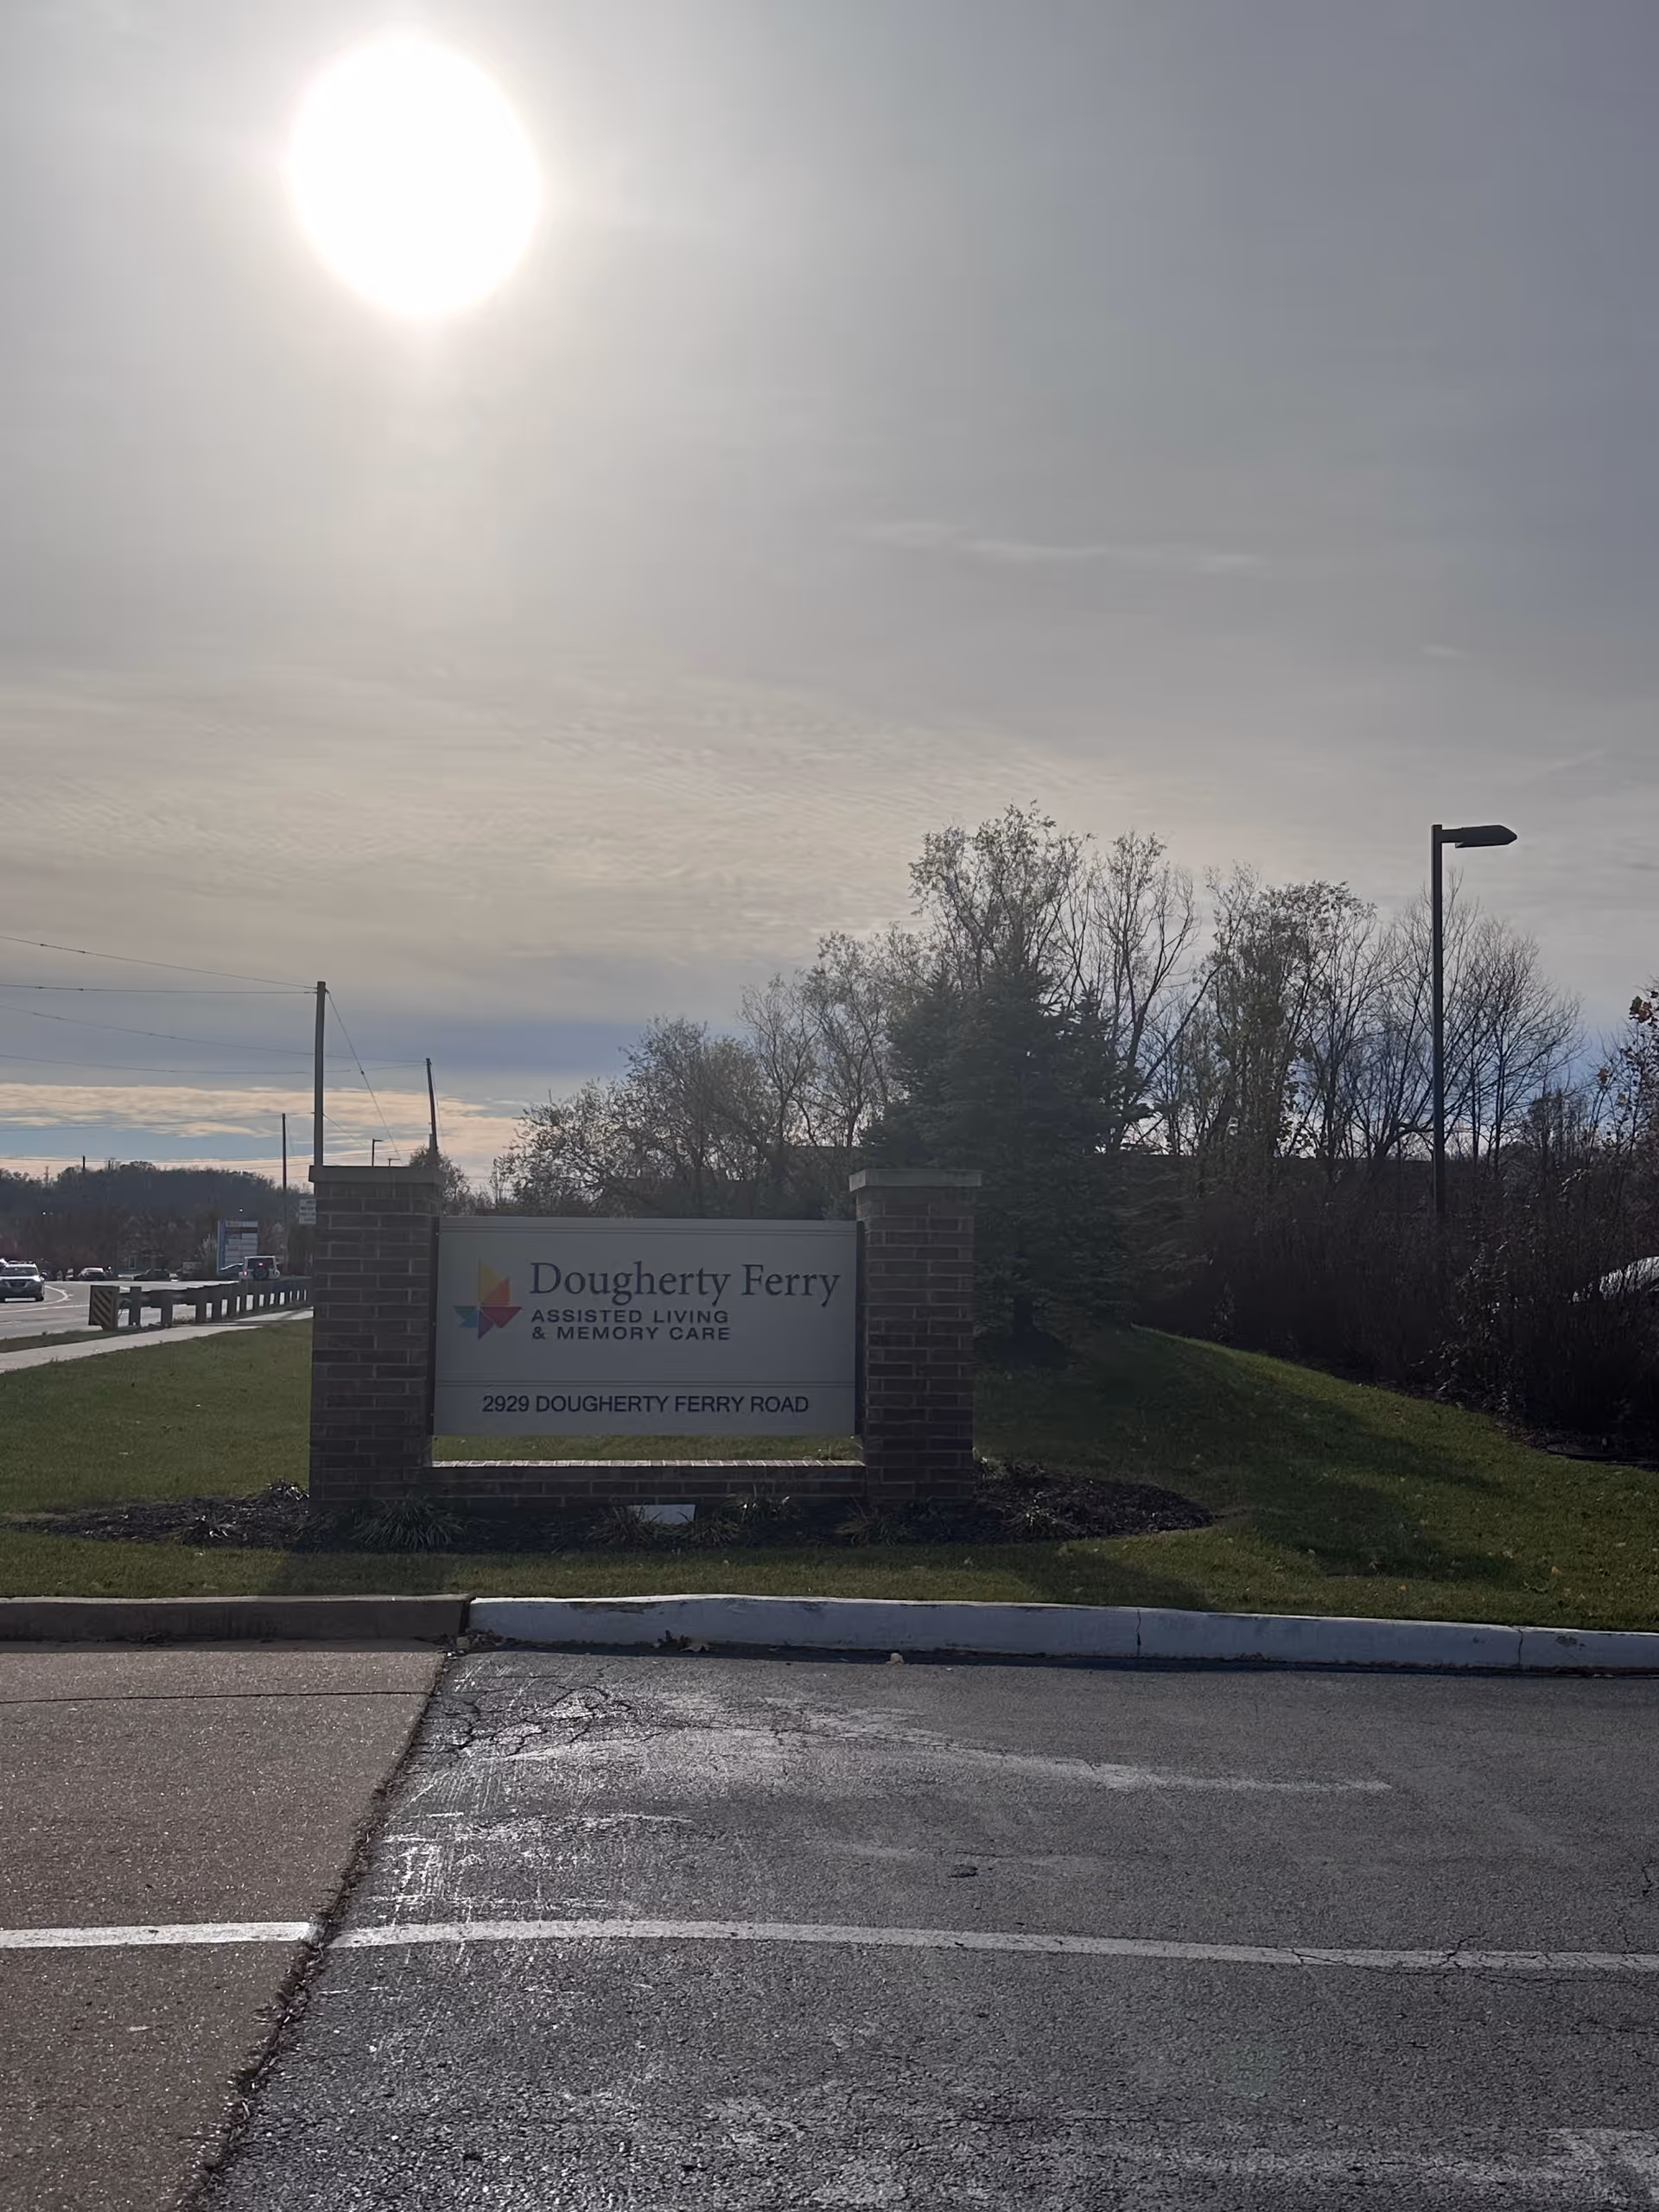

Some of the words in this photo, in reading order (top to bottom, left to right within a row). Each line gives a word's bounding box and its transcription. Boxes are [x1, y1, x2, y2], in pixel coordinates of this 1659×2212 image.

[530, 1261, 732, 1306] Dougherty
[741, 1263, 842, 1307] Ferry
[531, 1309, 642, 1324] ASSISTED
[654, 1310, 728, 1324] LIVING
[531, 1326, 546, 1340] &
[557, 1326, 658, 1340] MEMORY
[669, 1327, 731, 1341] CARE
[482, 1395, 530, 1413] 2929
[536, 1395, 668, 1413] DOUGHERTY
[675, 1395, 745, 1413] FERRY
[750, 1396, 810, 1414] ROAD
